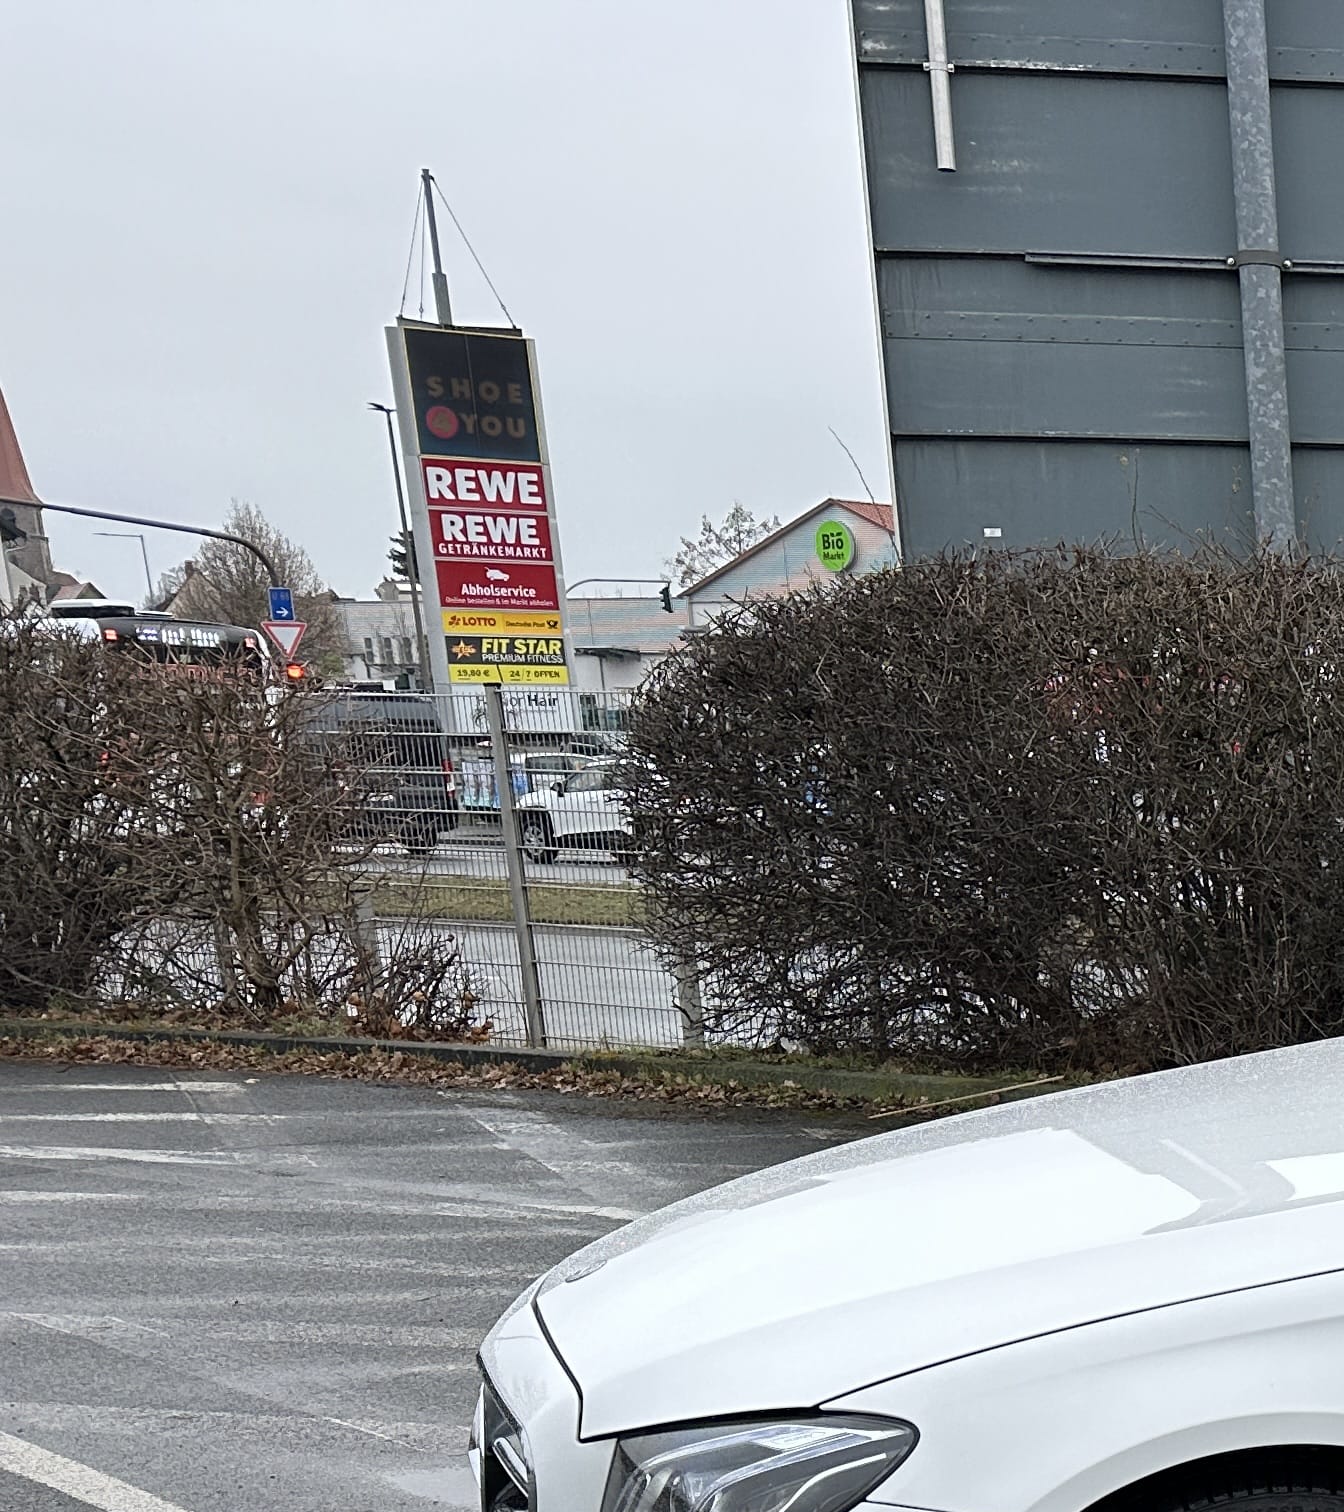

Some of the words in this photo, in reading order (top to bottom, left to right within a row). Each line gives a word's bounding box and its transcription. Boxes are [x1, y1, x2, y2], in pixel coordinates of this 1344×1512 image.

[425, 376, 523, 404] SHOE
[426, 466, 543, 505] REWE
[441, 513, 540, 545] REWE
[438, 541, 547, 559] GETRÄNKEMARKT
[461, 583, 536, 598] Abholservice
[463, 616, 496, 627] LOTTO
[481, 638, 511, 654] FIT
[514, 639, 562, 655] STAR
[482, 653, 526, 663] PREMIUM
[527, 654, 564, 664] FITNESS
